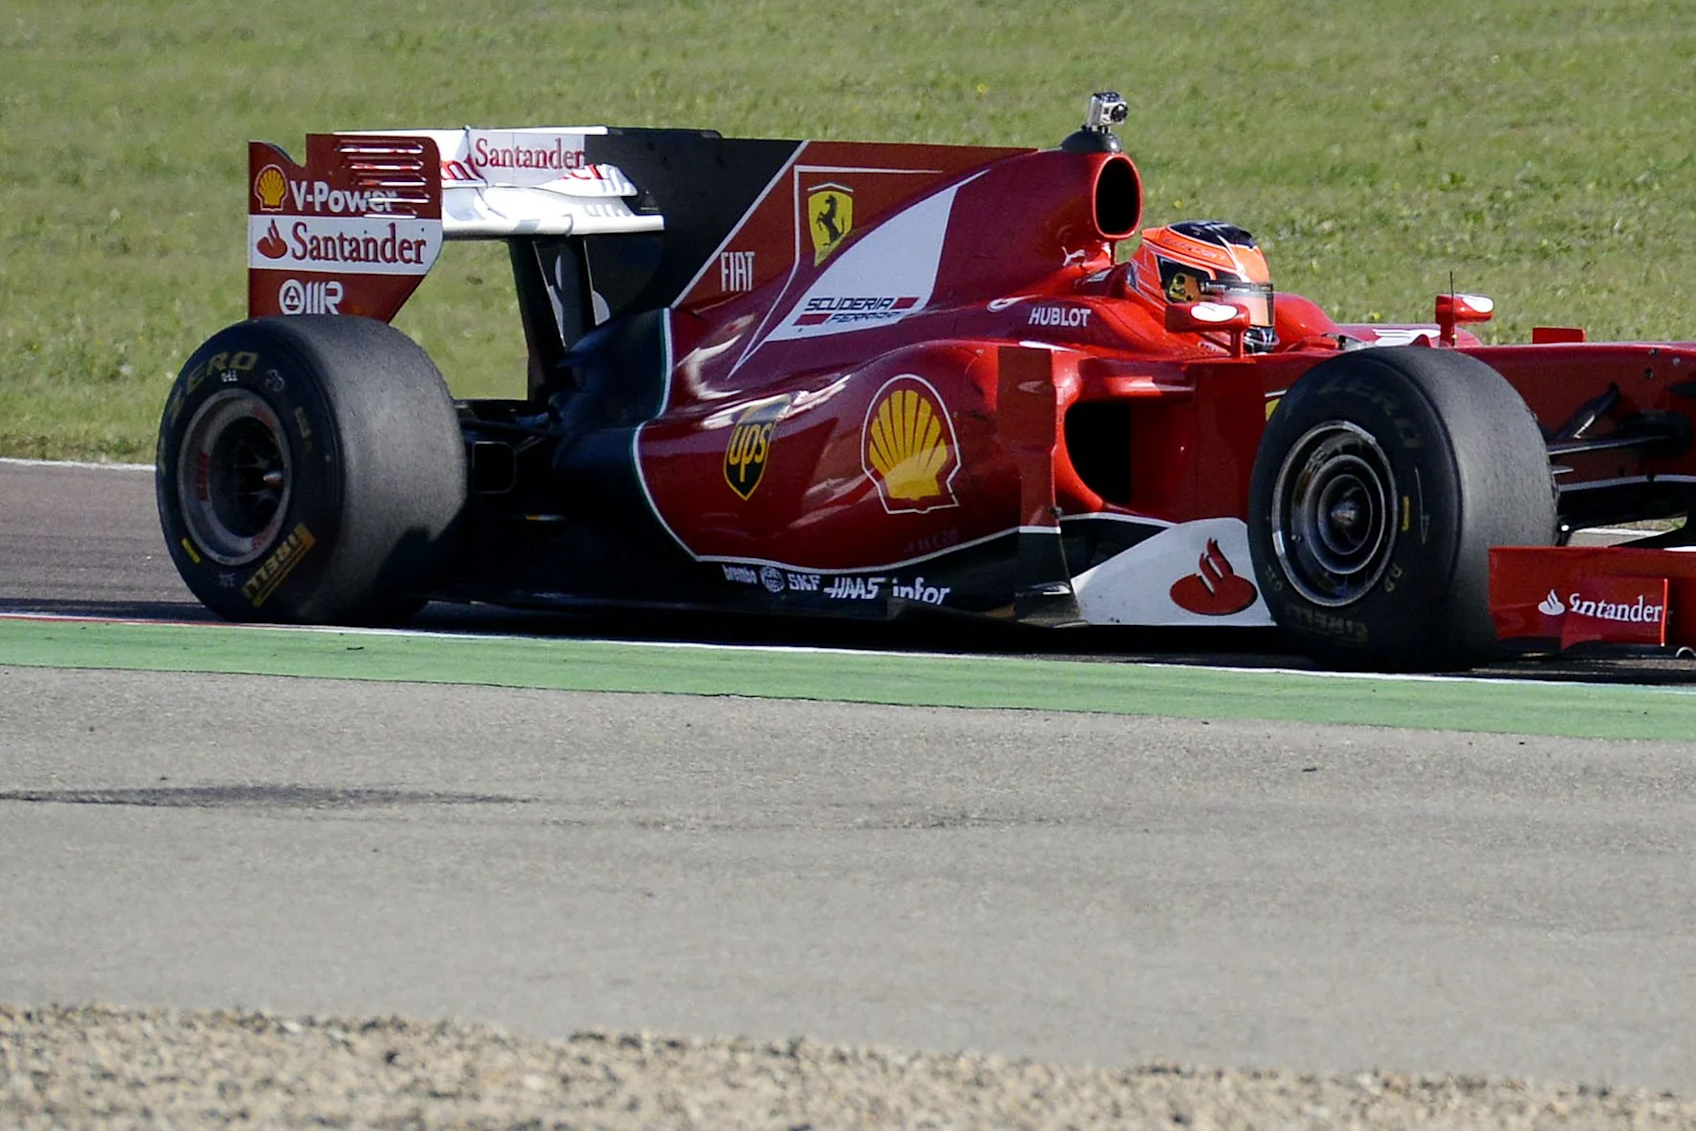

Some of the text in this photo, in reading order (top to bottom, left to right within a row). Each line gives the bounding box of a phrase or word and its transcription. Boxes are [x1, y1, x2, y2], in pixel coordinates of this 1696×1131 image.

[475, 138, 585, 169] Santander
[290, 180, 397, 212] V-Power
[291, 222, 427, 264] Santander
[720, 252, 755, 292] FIAT
[804, 297, 894, 311] SCUDERIA
[1028, 307, 1092, 327] HUBLOT
[787, 574, 821, 591] SKF
[892, 578, 951, 605] infor
